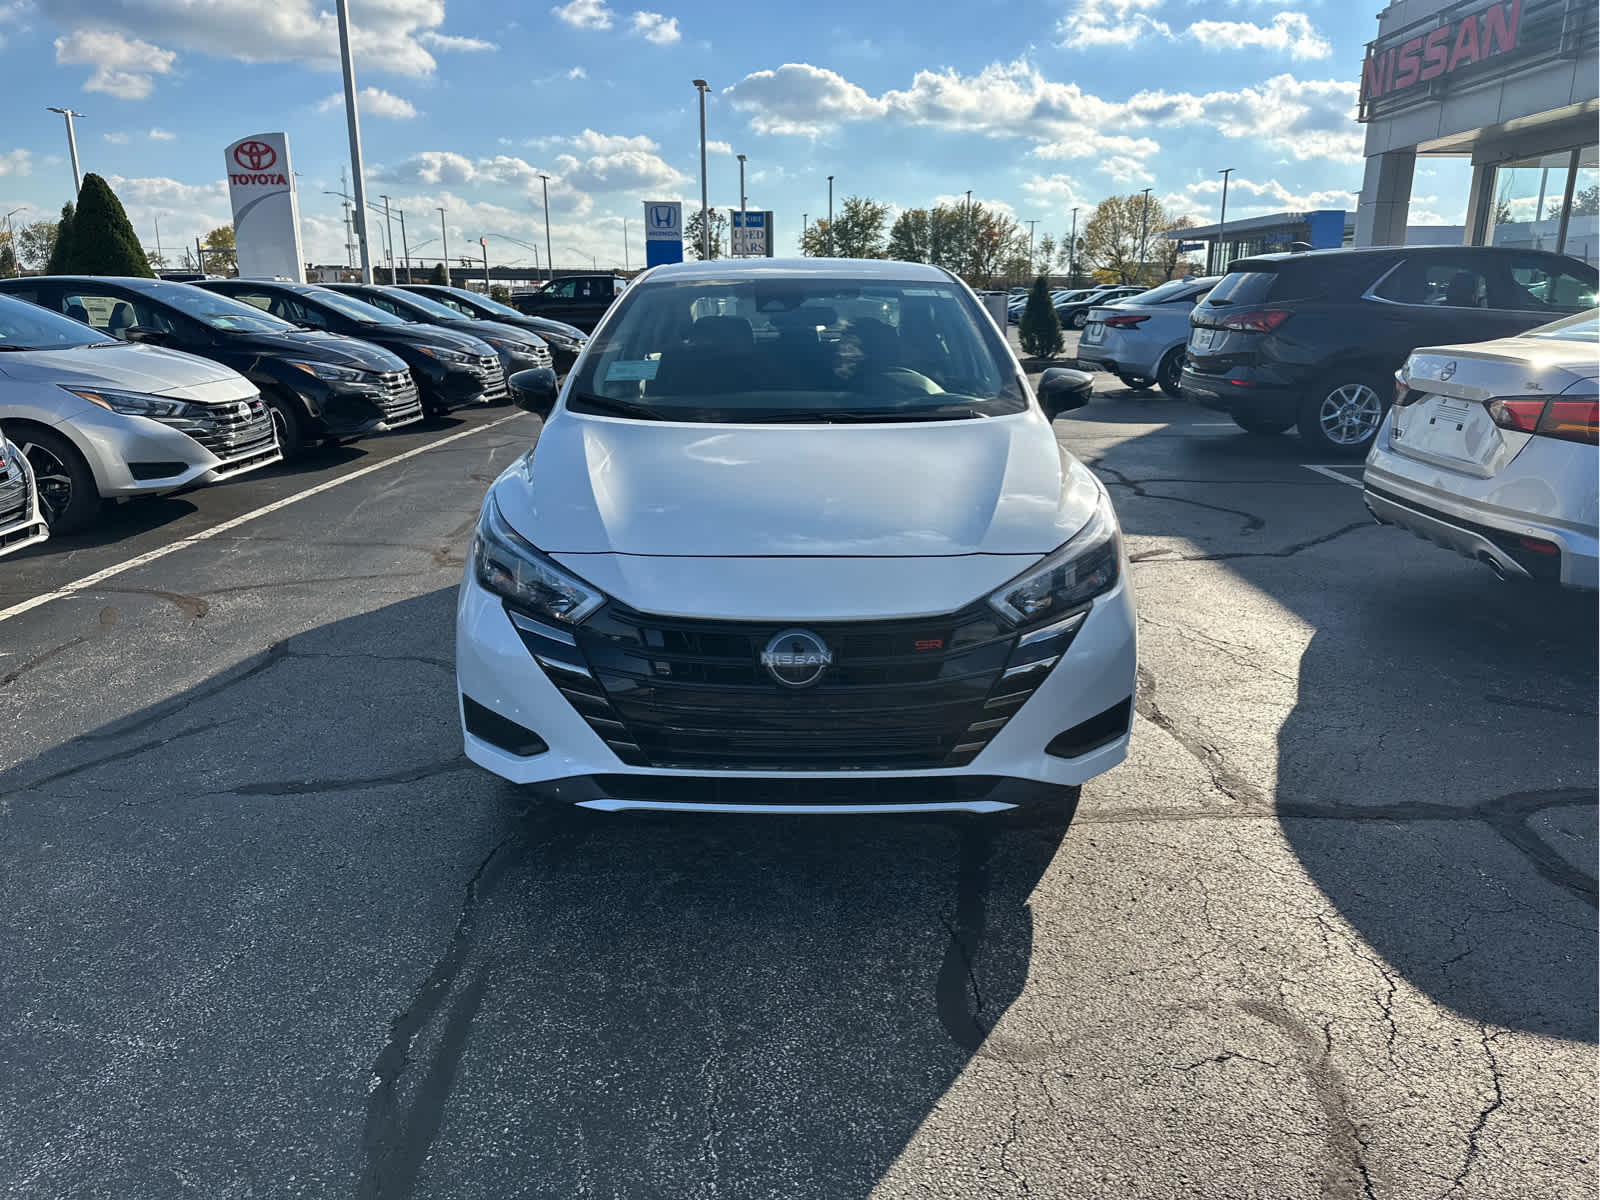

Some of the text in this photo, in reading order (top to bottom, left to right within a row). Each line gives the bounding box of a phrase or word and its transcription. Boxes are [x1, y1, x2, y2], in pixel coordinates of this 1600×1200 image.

[1361, 0, 1521, 98] NISSAN
[230, 174, 287, 185] TOYOTA
[915, 640, 943, 650] SR
[761, 652, 832, 665] NISSAN
